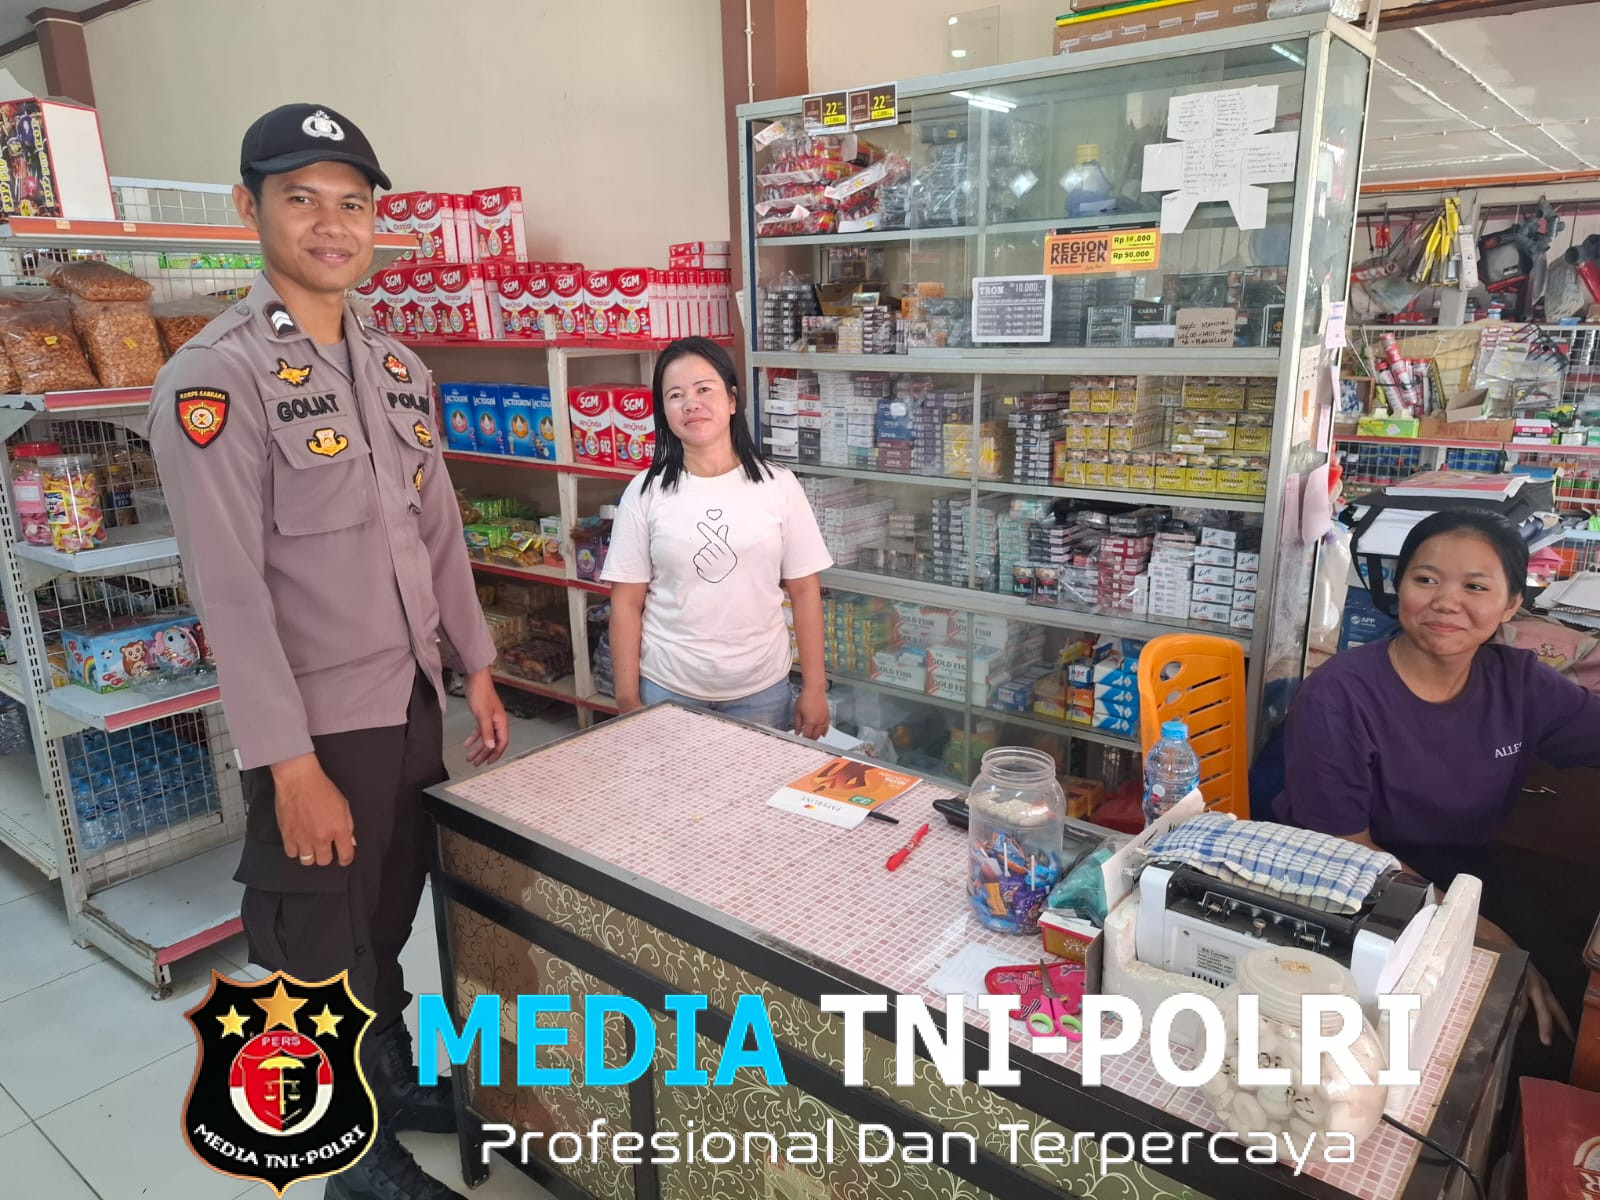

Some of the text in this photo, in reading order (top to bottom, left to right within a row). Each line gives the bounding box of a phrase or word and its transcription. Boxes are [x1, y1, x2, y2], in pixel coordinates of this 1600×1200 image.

[826, 102, 838, 116] 22
[873, 95, 886, 109] 22
[390, 199, 407, 215] SGM
[417, 199, 432, 214] SGM
[482, 193, 501, 210] SGM
[1114, 236, 1125, 244] Rp
[1051, 252, 1106, 265] KRETEK
[1125, 250, 1150, 258] 50.000
[385, 274, 402, 288] SGM
[414, 272, 433, 287] SGM
[443, 270, 461, 286] SGM
[530, 278, 546, 291] SGM
[558, 277, 574, 289] SGM
[590, 276, 608, 289] SGM
[621, 275, 640, 288] SGM
[503, 280, 519, 293] SGM
[979, 286, 1005, 295] TRON
[277, 393, 340, 422] GOLIAT
[579, 395, 600, 409] SGM
[623, 397, 645, 411] SGM
[975, 628, 992, 637] FISH
[931, 658, 952, 668] GOLD
[933, 680, 952, 689] GOLD
